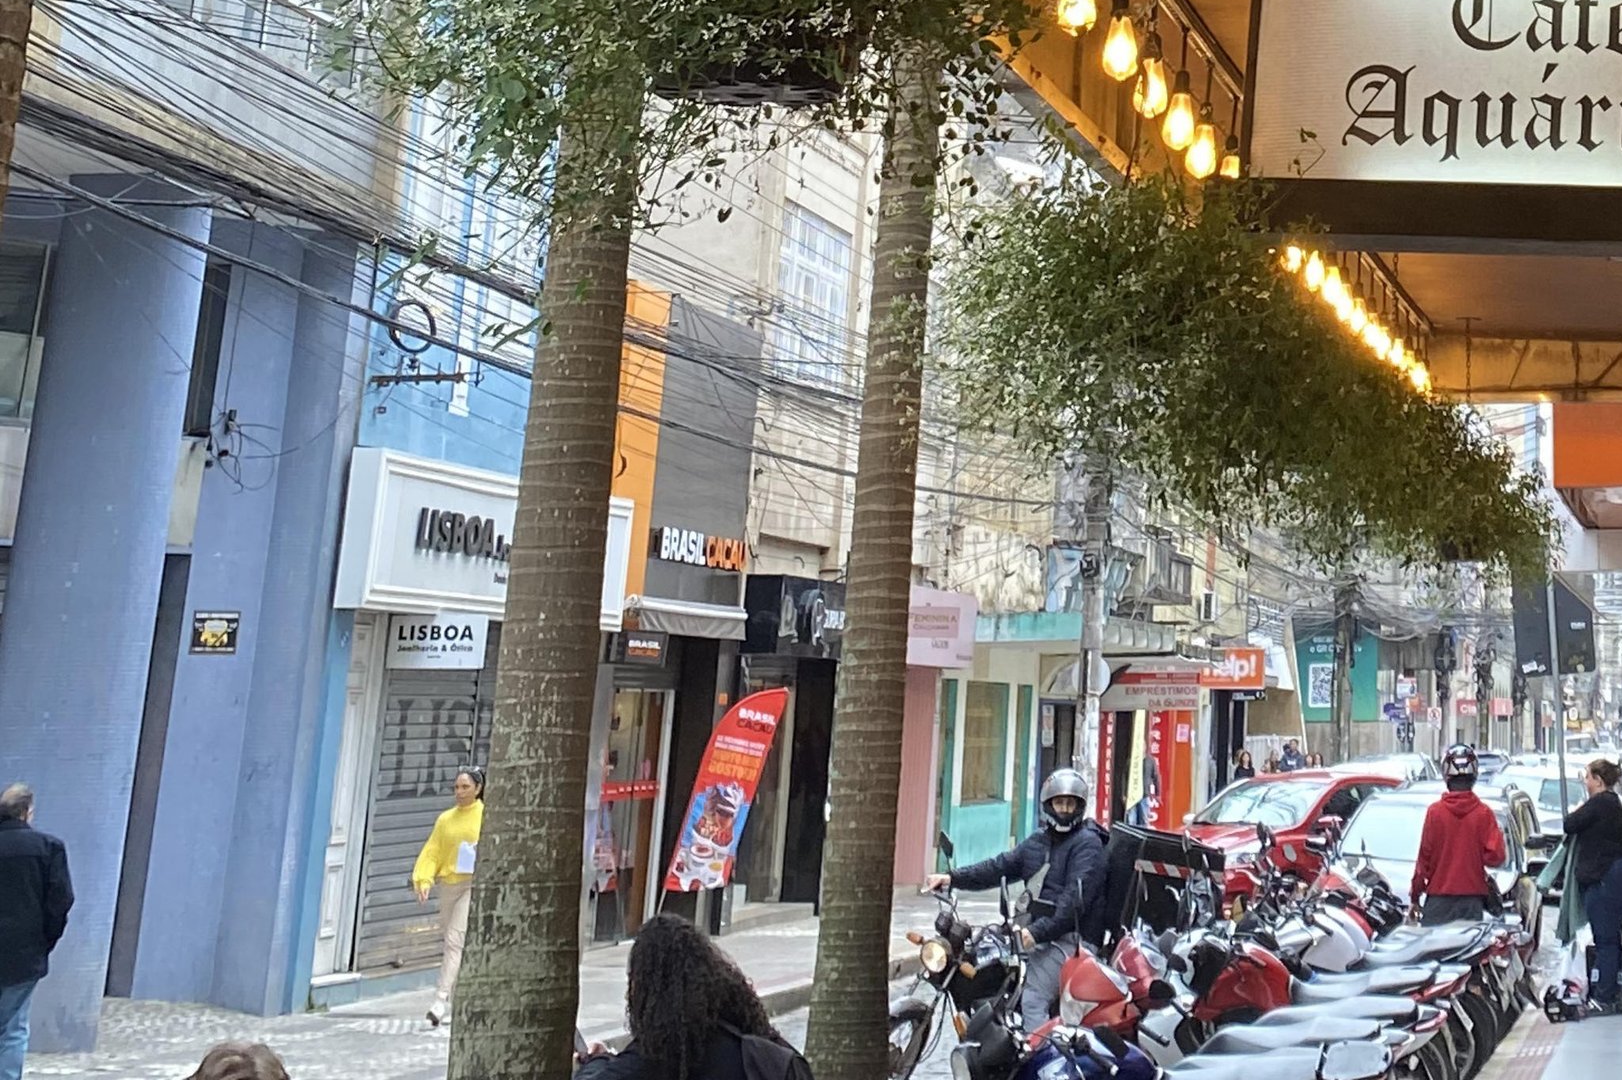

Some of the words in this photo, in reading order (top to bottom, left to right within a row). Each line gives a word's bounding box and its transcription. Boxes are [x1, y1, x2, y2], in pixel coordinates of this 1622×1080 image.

[414, 507, 495, 558] LISBOA
[660, 526, 706, 566] BRASIL
[706, 535, 749, 572] CACAU
[397, 625, 474, 641] LISBOA
[628, 639, 661, 650] BRASIL
[1125, 685, 1198, 696] EMPRÉSTIMOS
[738, 708, 776, 726] BRASIL
